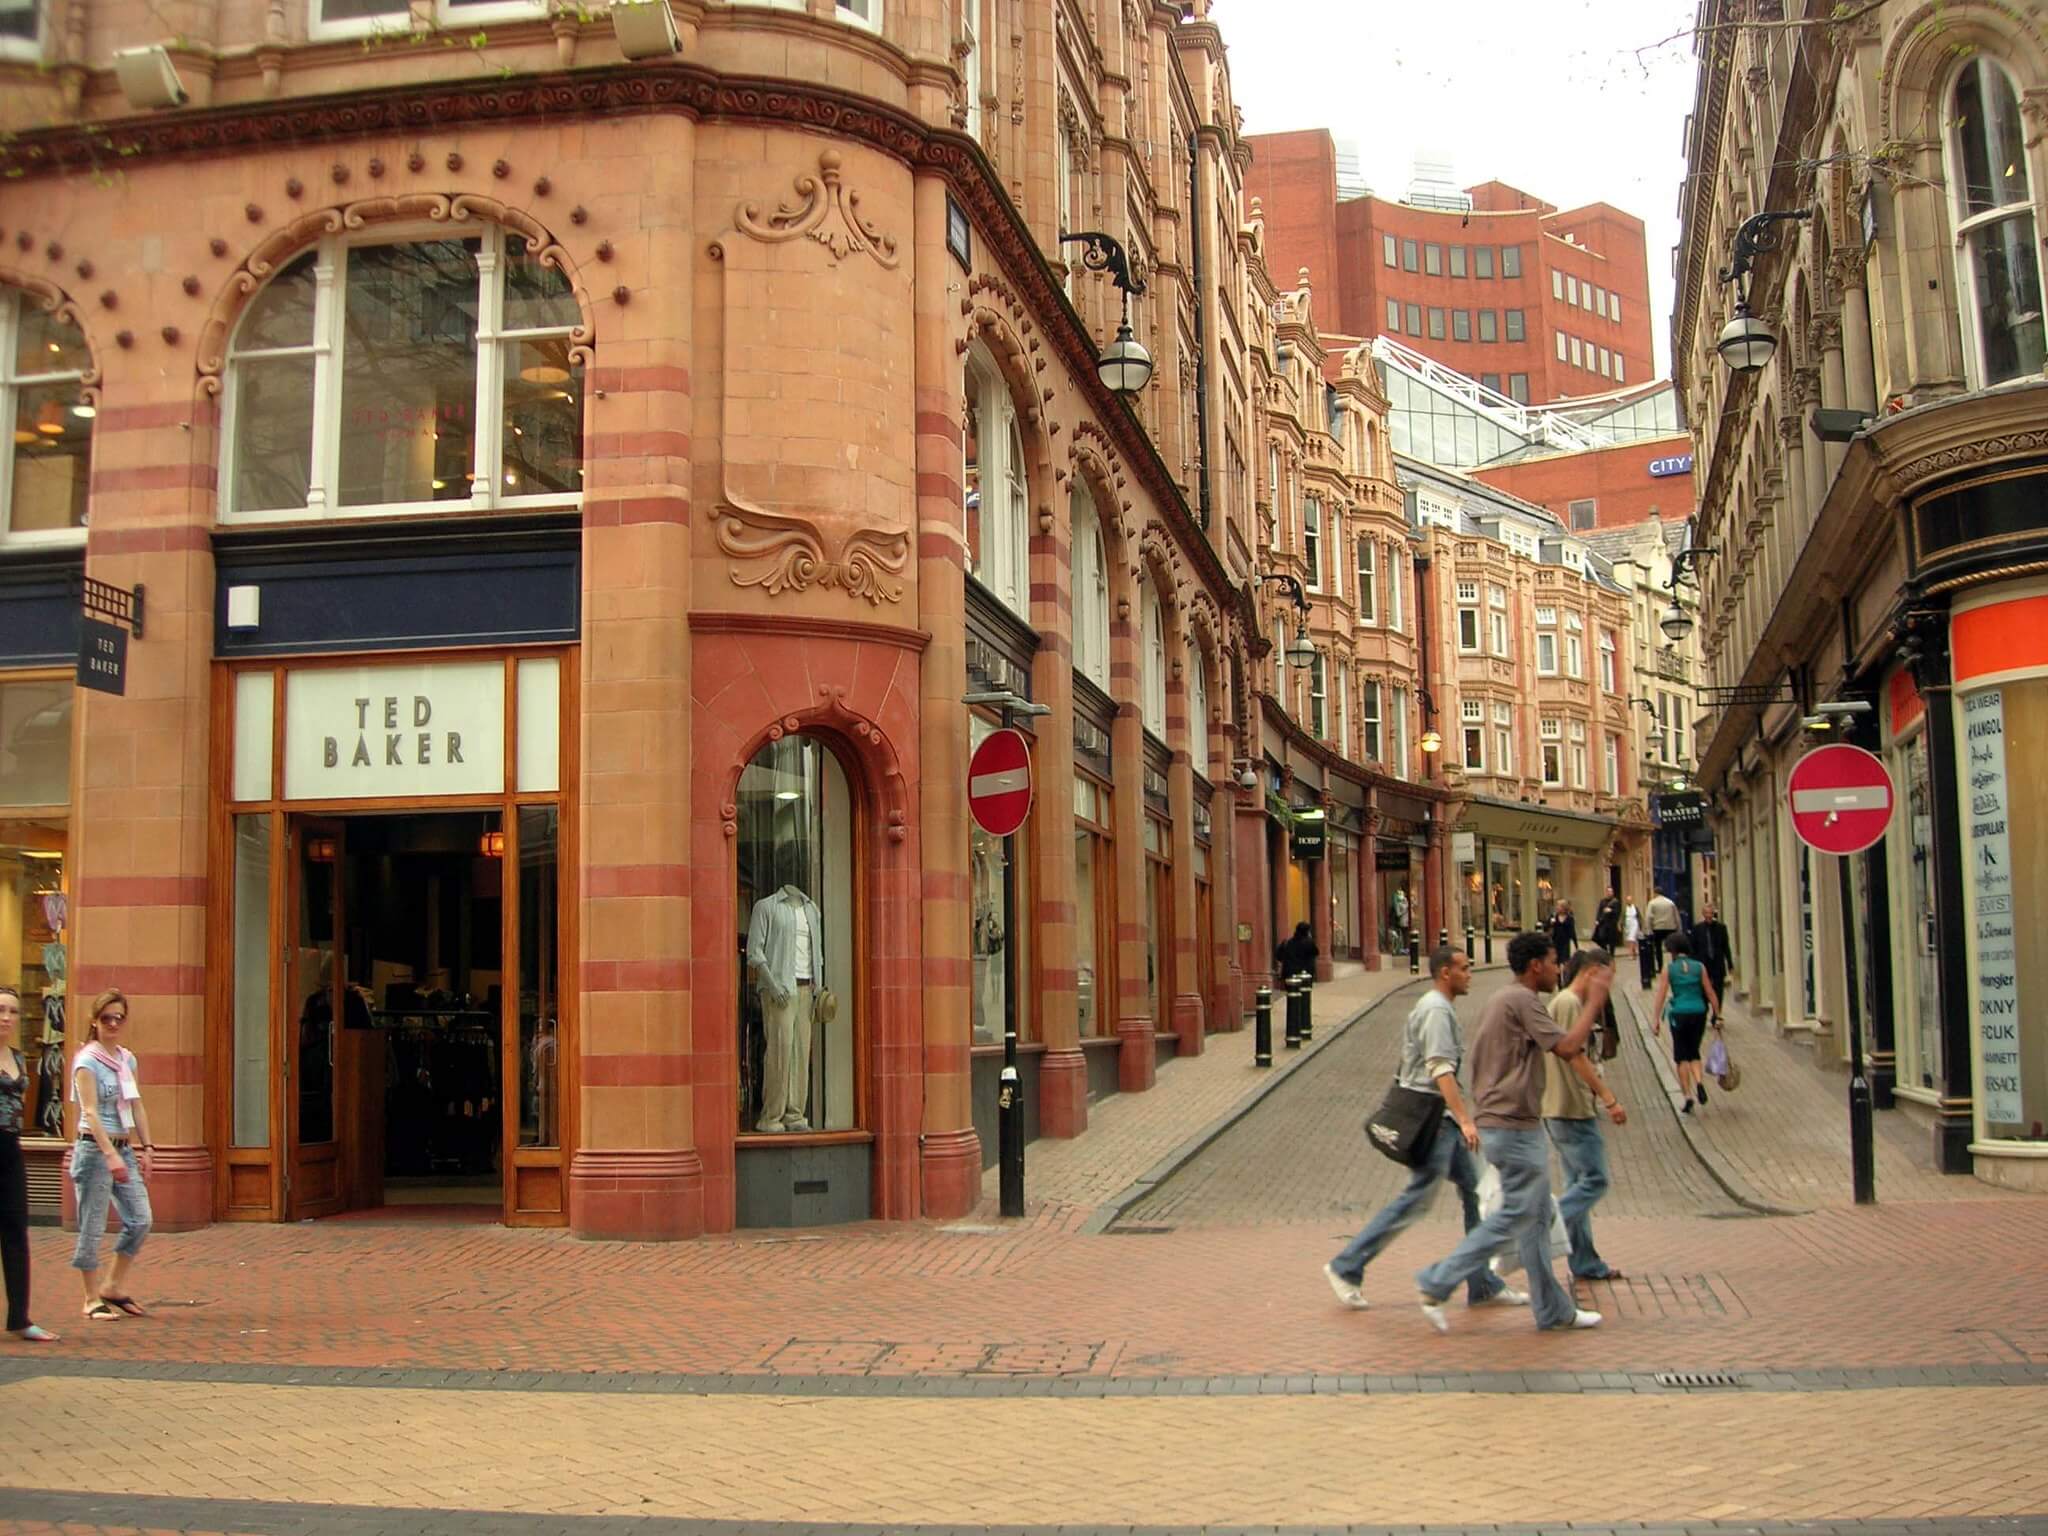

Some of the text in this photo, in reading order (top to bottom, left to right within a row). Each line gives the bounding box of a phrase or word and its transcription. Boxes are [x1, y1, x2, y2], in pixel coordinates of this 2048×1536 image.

[1649, 457, 1686, 473] CITY
[97, 638, 115, 654] TED
[90, 657, 119, 676] BAKER
[354, 694, 433, 730] TED
[323, 730, 465, 769] BAKER
